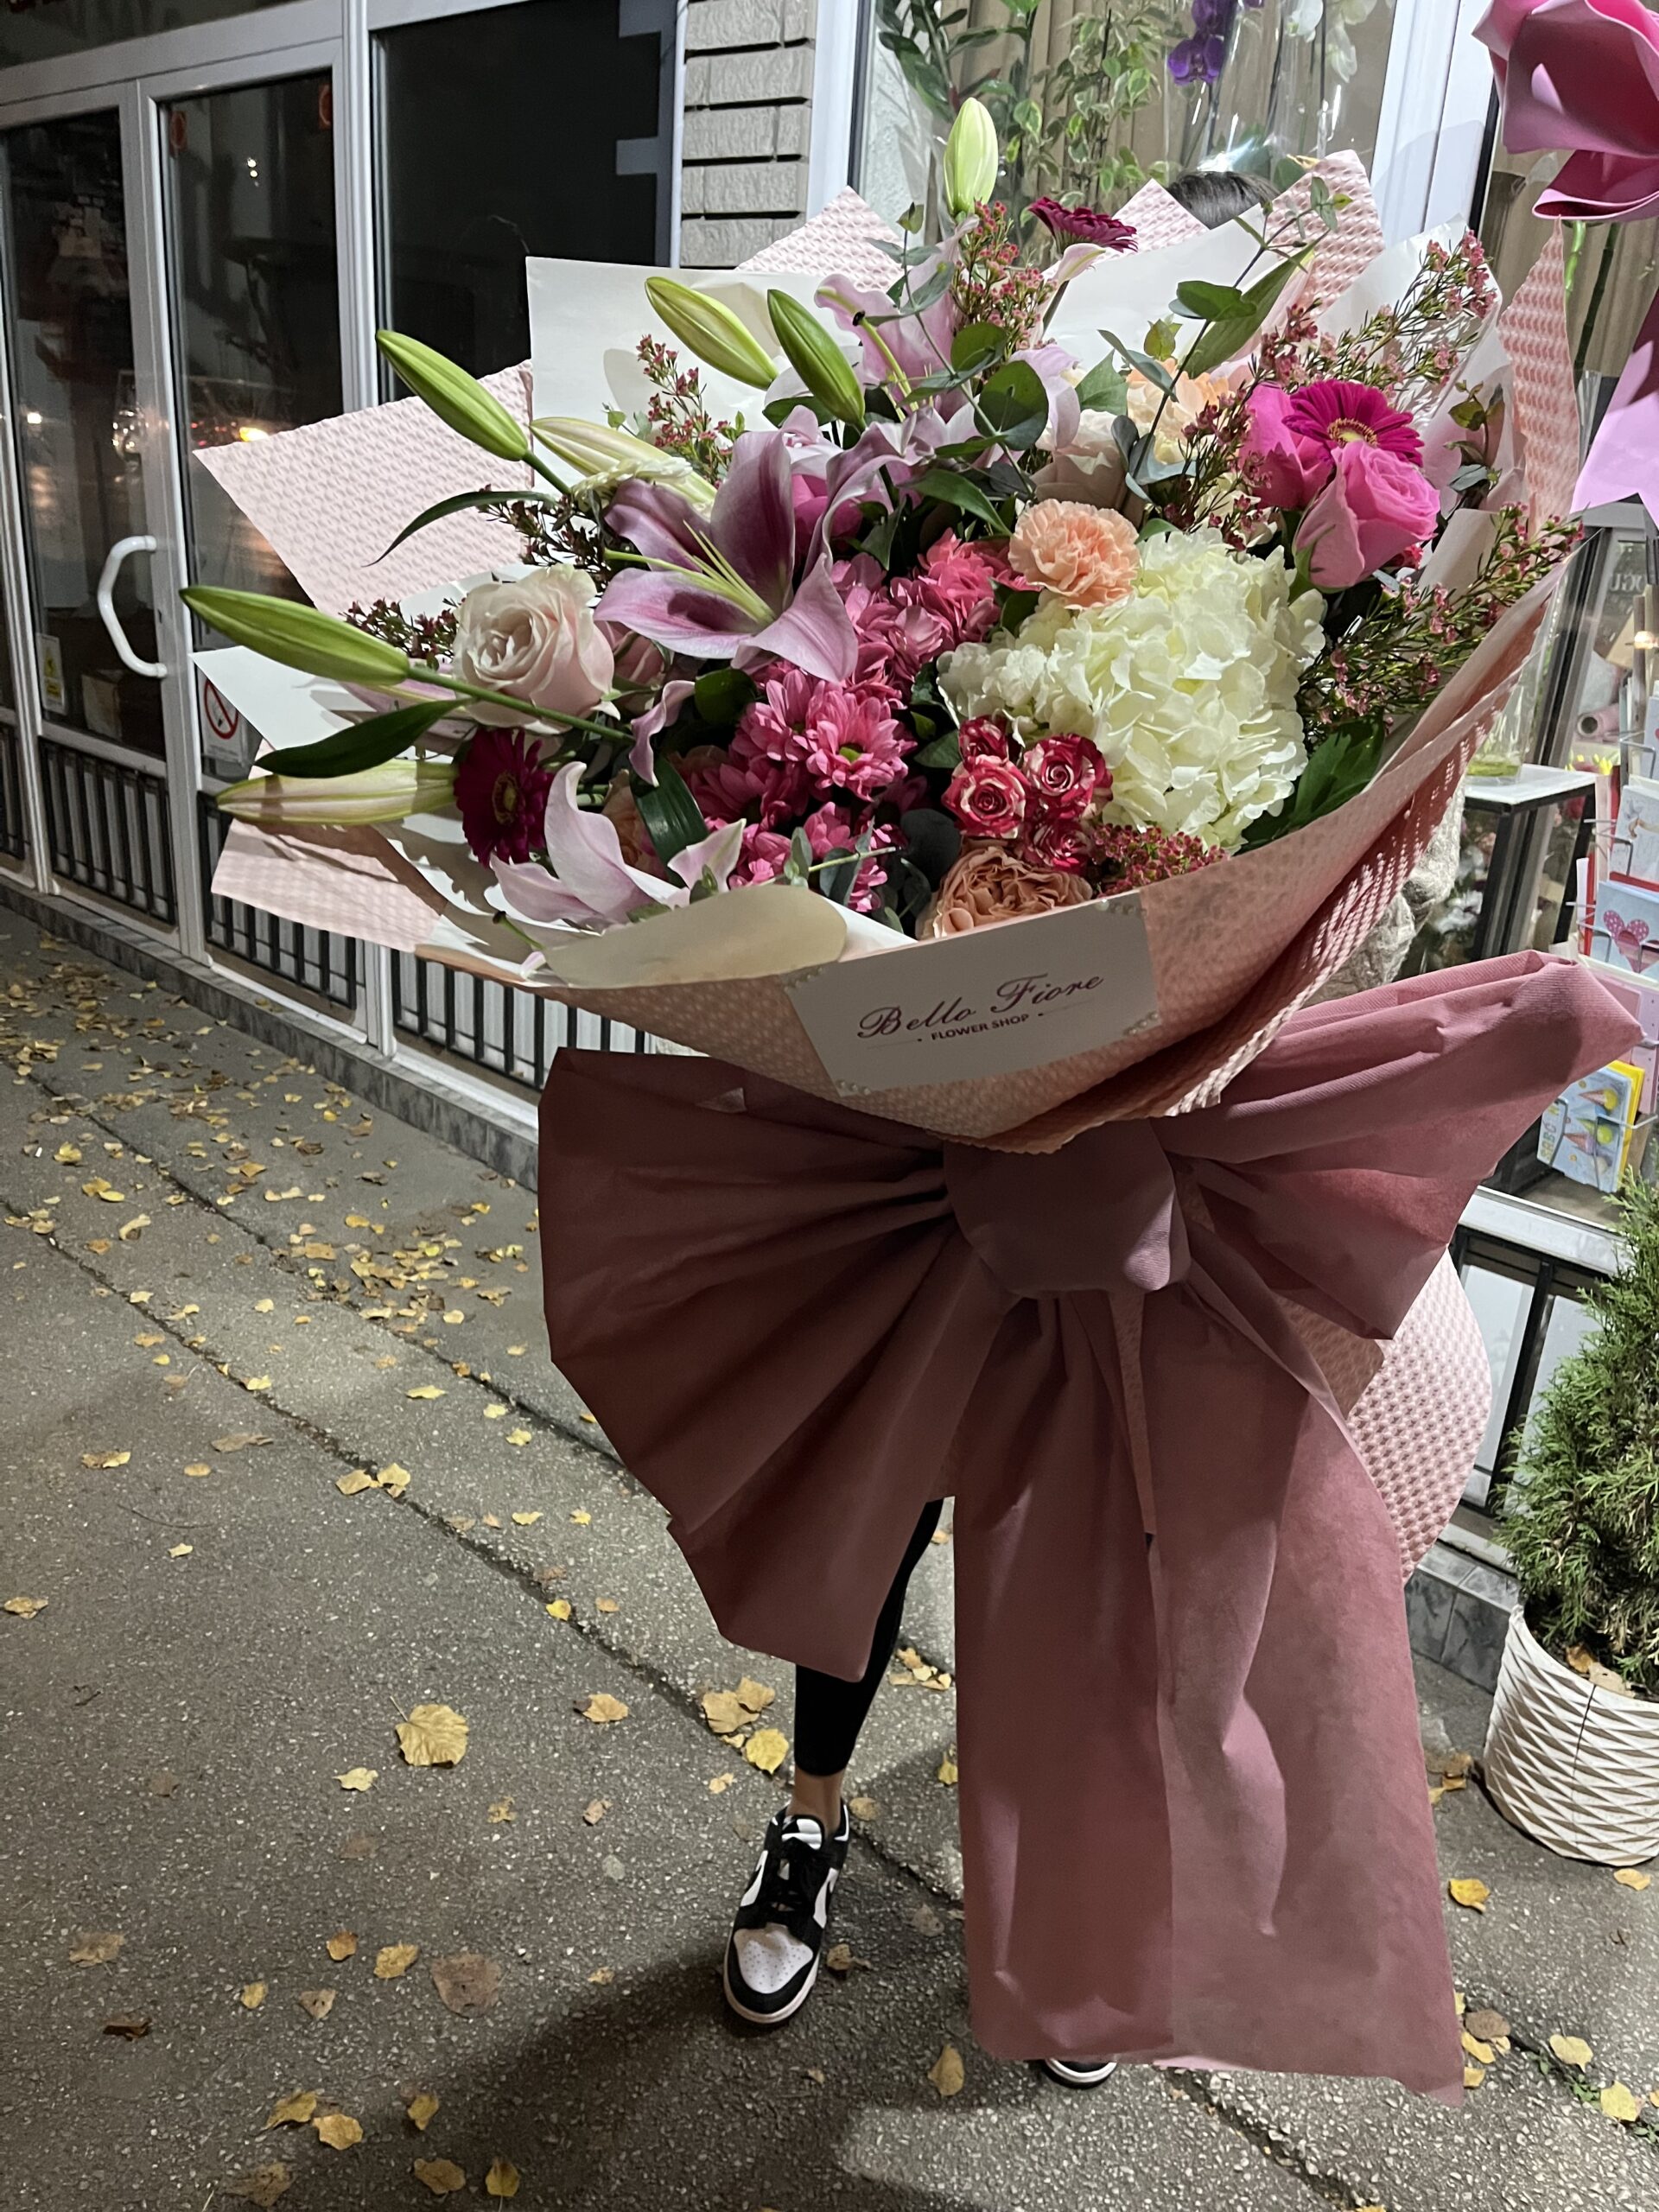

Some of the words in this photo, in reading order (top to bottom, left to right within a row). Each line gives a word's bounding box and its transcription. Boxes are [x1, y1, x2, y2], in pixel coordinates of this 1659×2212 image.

[857, 996, 976, 1039] Bello
[990, 973, 1104, 1013] Fiore
[931, 1023, 988, 1040] FLOWER
[992, 1014, 1029, 1029] SHOP
